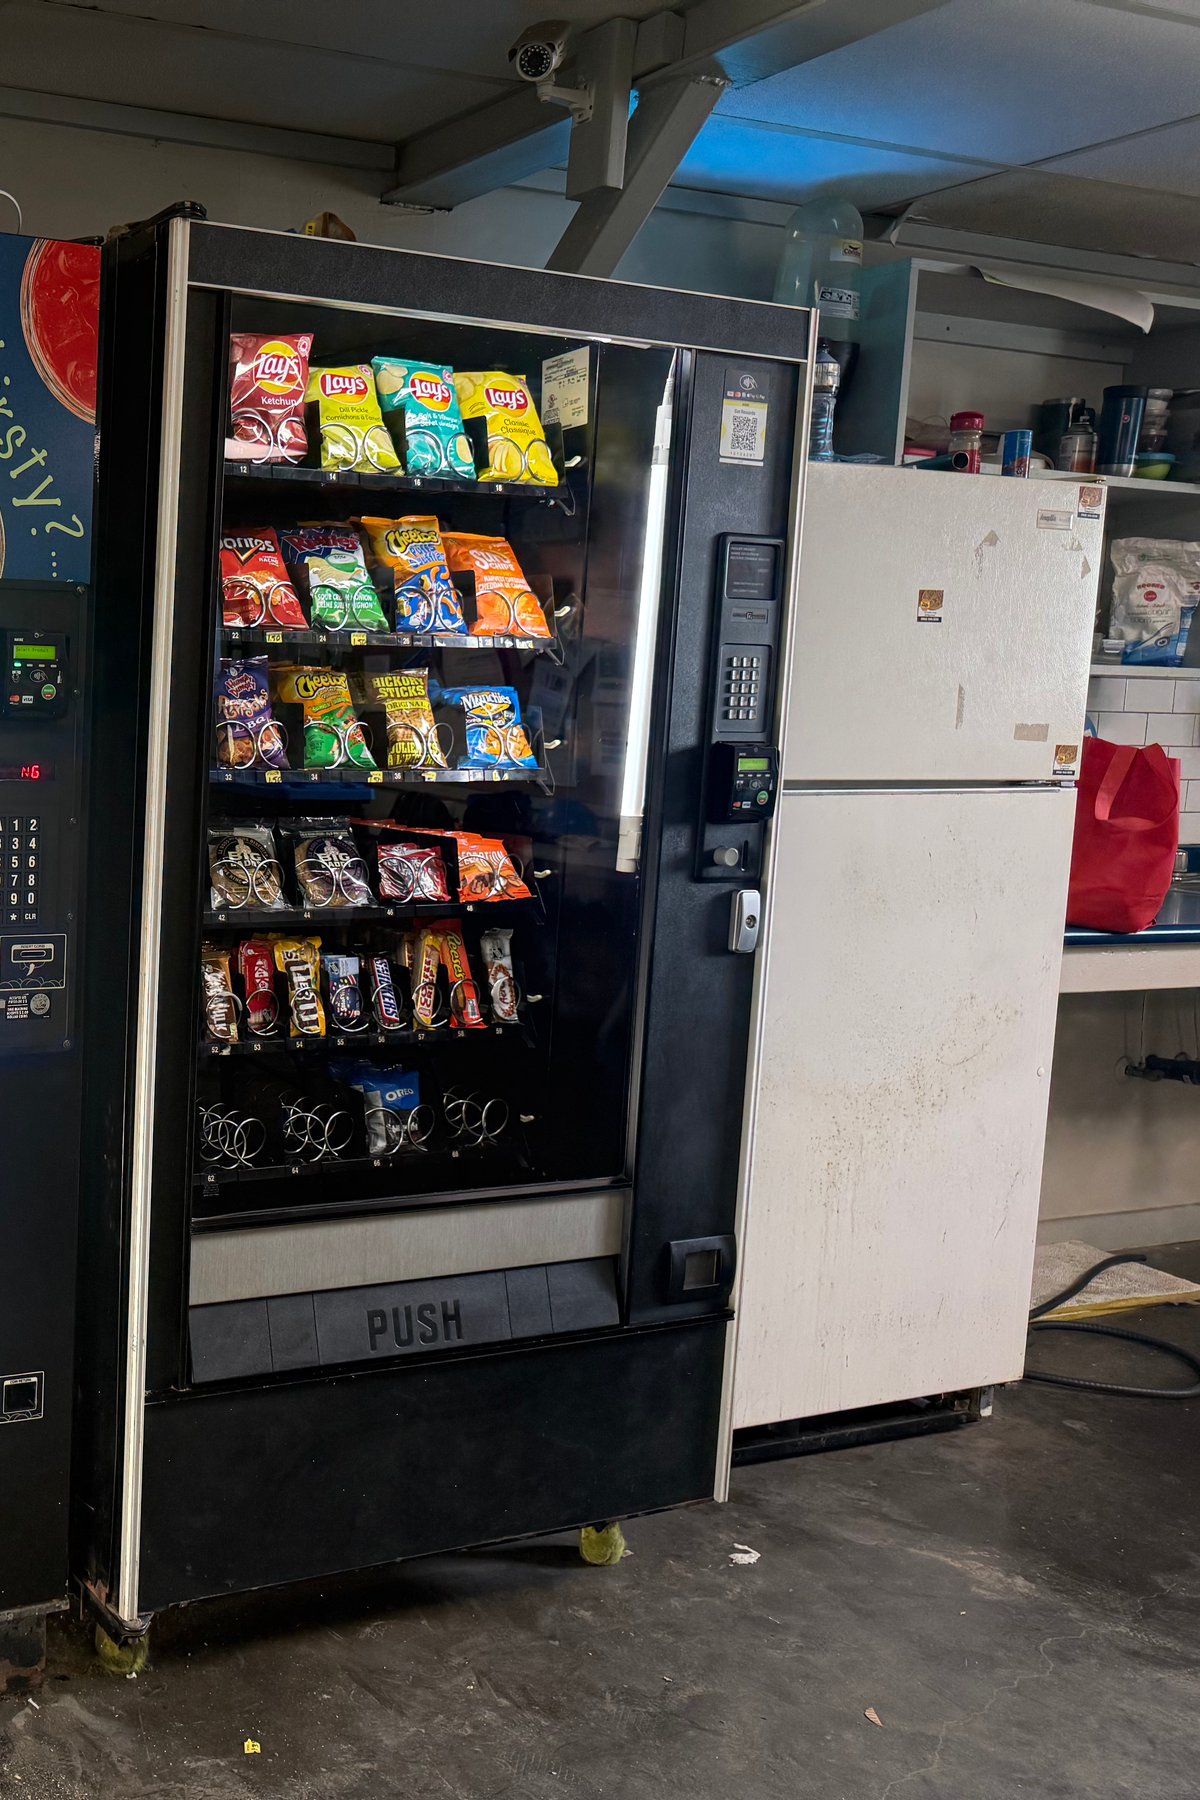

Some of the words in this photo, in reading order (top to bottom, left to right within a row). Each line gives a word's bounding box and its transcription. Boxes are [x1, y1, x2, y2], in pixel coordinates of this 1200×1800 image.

[256, 353, 299, 383] Lay's
[326, 374, 366, 395] Lay's
[414, 378, 450, 402] Lay's
[261, 396, 297, 406] Ketchup
[489, 388, 525, 409] Lay's
[350, 406, 369, 414] Pickle
[504, 418, 529, 428] Classic
[500, 427, 536, 435] Classique
[240, 465, 247, 473] 12
[387, 529, 439, 555] Cheetos
[488, 562, 516, 571] CHIPS
[232, 631, 239, 639] 22
[296, 672, 348, 698] Cheetos
[373, 676, 425, 688] HICKORY
[379, 685, 426, 698] STICKS
[386, 700, 426, 711] ORIGINAL
[225, 773, 232, 781] 32
[311, 773, 318, 781] 34
[13, 819, 19, 831] 1
[29, 819, 37, 831] 2
[11, 837, 19, 849] 3
[28, 837, 36, 849] 4
[11, 855, 19, 868] 5
[28, 855, 36, 868] 6
[228, 851, 262, 862] BIG
[319, 852, 350, 862] BIG
[11, 874, 18, 886] 7
[28, 874, 35, 886] 8
[10, 893, 18, 905] 9
[27, 892, 35, 904] 0
[448, 930, 466, 980] Reese's
[374, 958, 399, 1020] SNICKERS
[385, 1088, 414, 1101] OREO
[366, 1299, 464, 1351] PUSH
